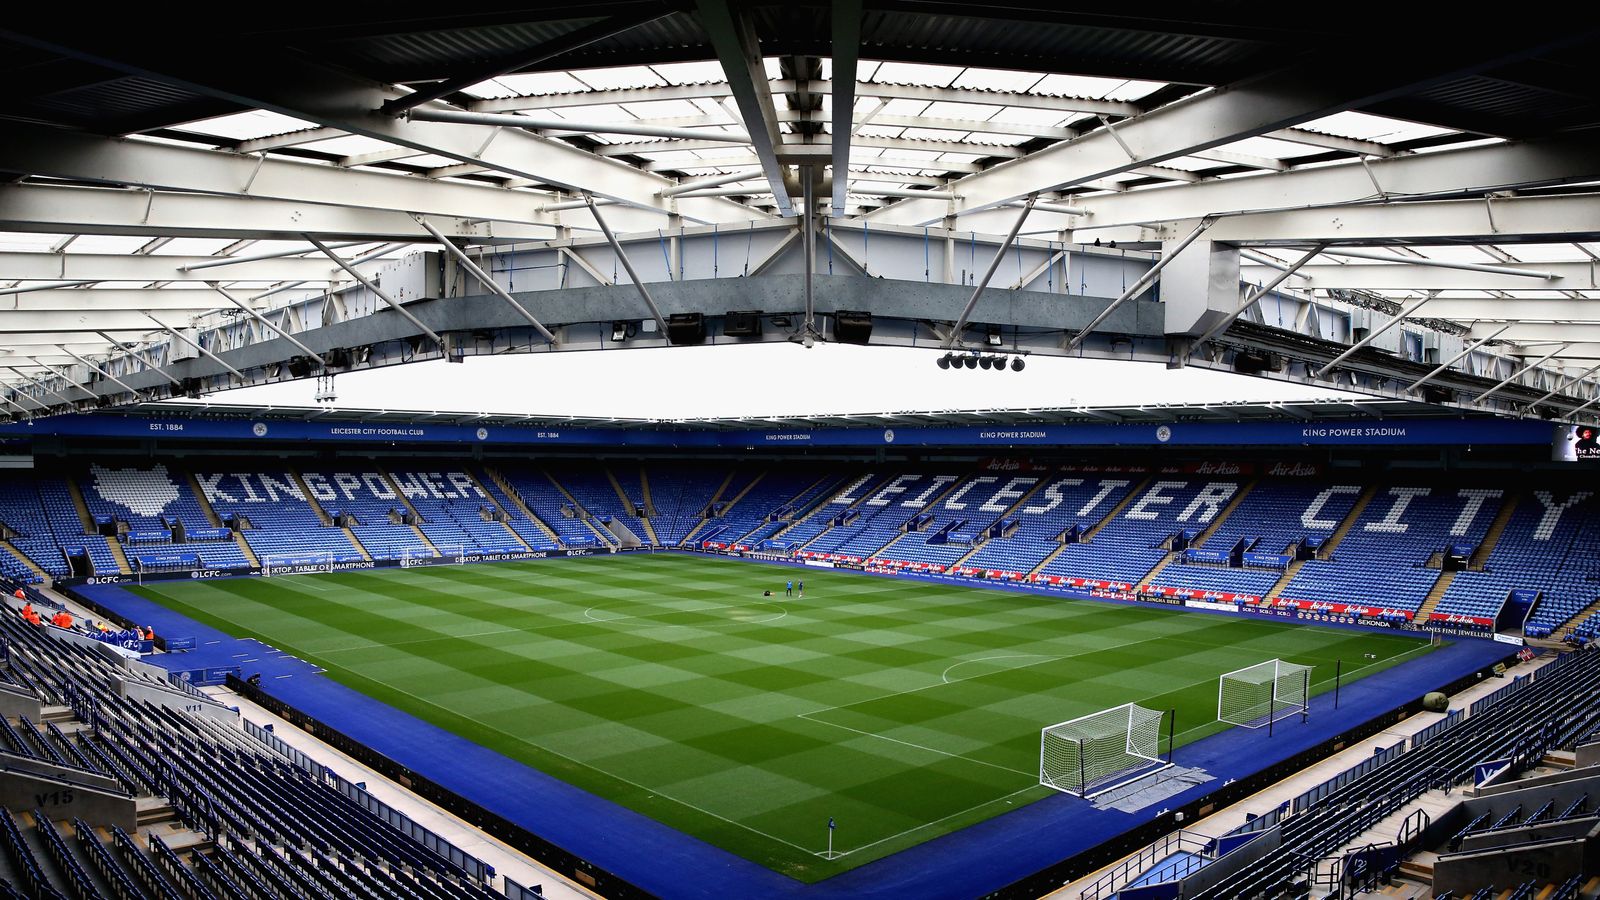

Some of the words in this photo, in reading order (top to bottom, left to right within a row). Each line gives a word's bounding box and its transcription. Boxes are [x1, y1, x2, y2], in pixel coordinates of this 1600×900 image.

[1302, 429, 1326, 437] KING
[1329, 428, 1362, 436] POWER
[1365, 428, 1406, 436] STADIUM
[832, 474, 1238, 522] LEICESTER
[1301, 486, 1593, 540] CITY
[1357, 618, 1391, 628] SEKONDA
[1442, 627, 1457, 635] FINE
[1458, 629, 1493, 638] JEWELLERY
[186, 704, 202, 712] V11
[35, 789, 74, 807] V15
[1505, 853, 1551, 878] V20
